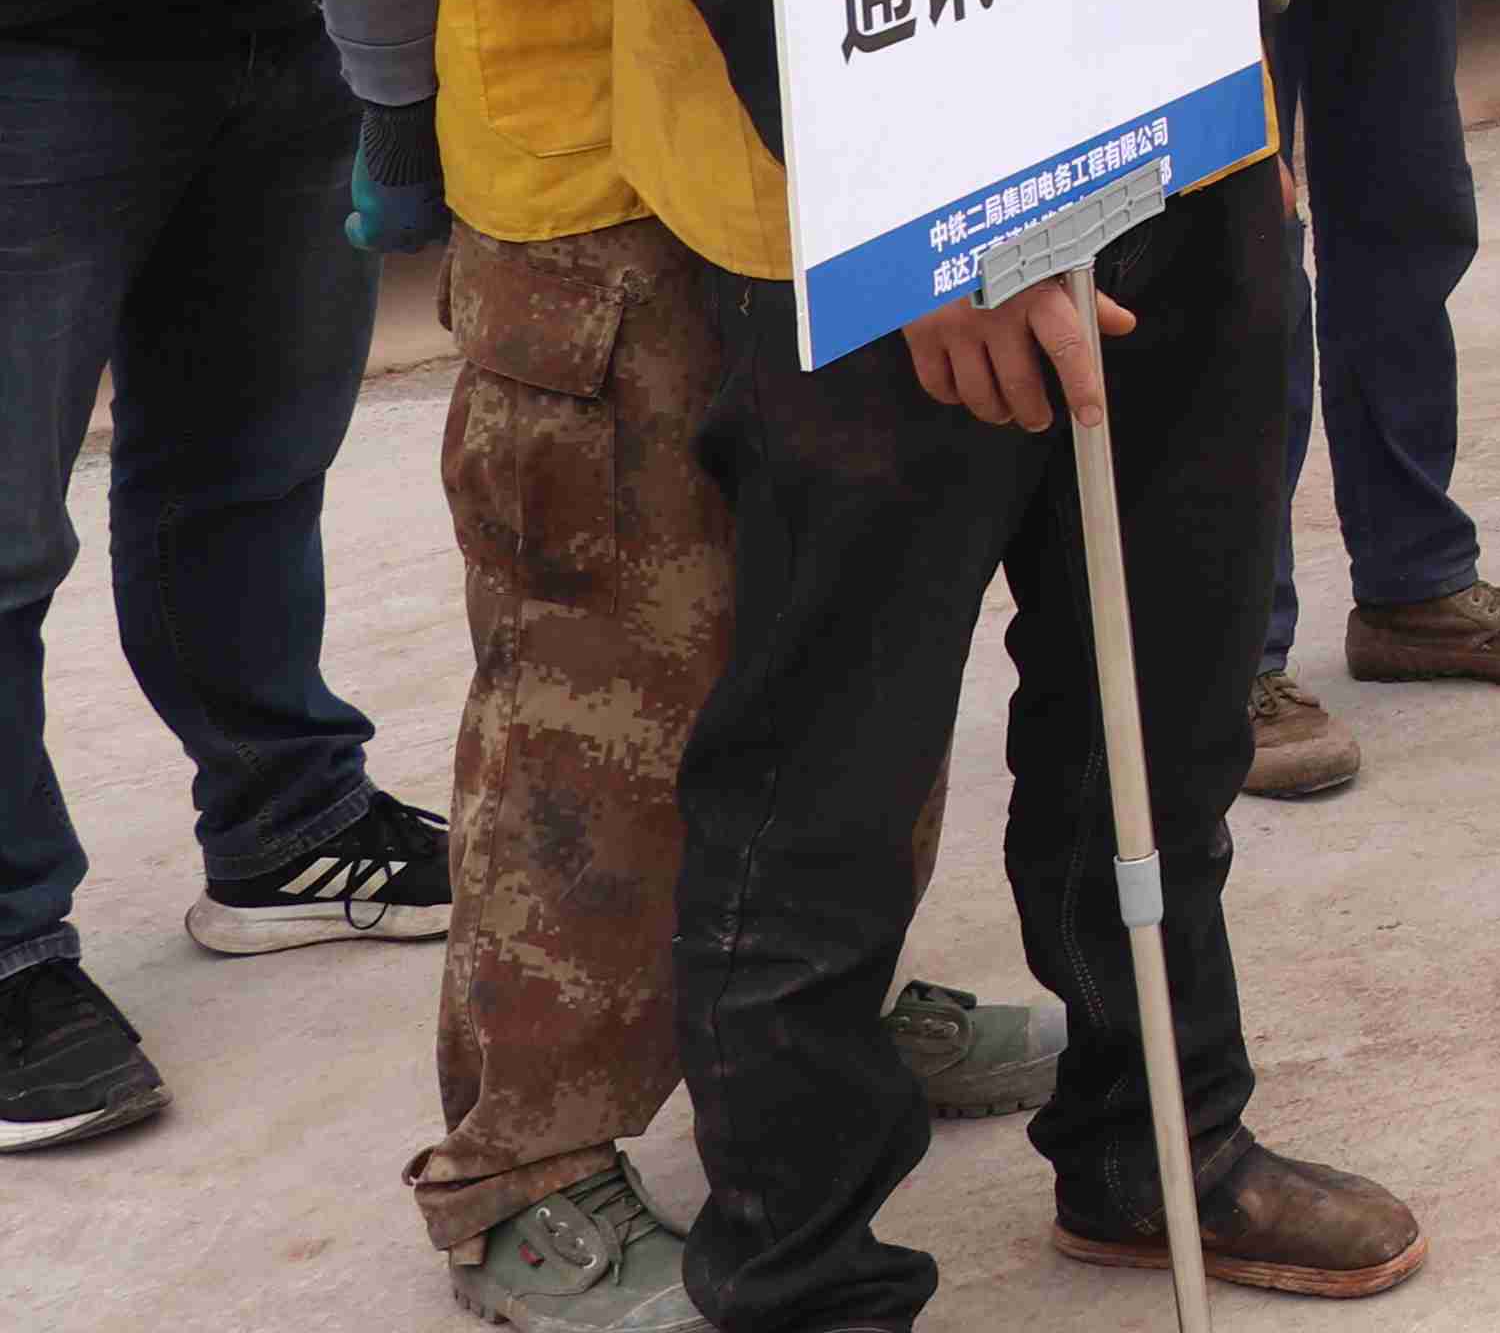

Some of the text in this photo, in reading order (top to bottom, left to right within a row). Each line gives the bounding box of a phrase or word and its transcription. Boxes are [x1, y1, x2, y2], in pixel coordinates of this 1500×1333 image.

[930, 116, 1168, 252] 中铁二局集团电务工程有限公司
